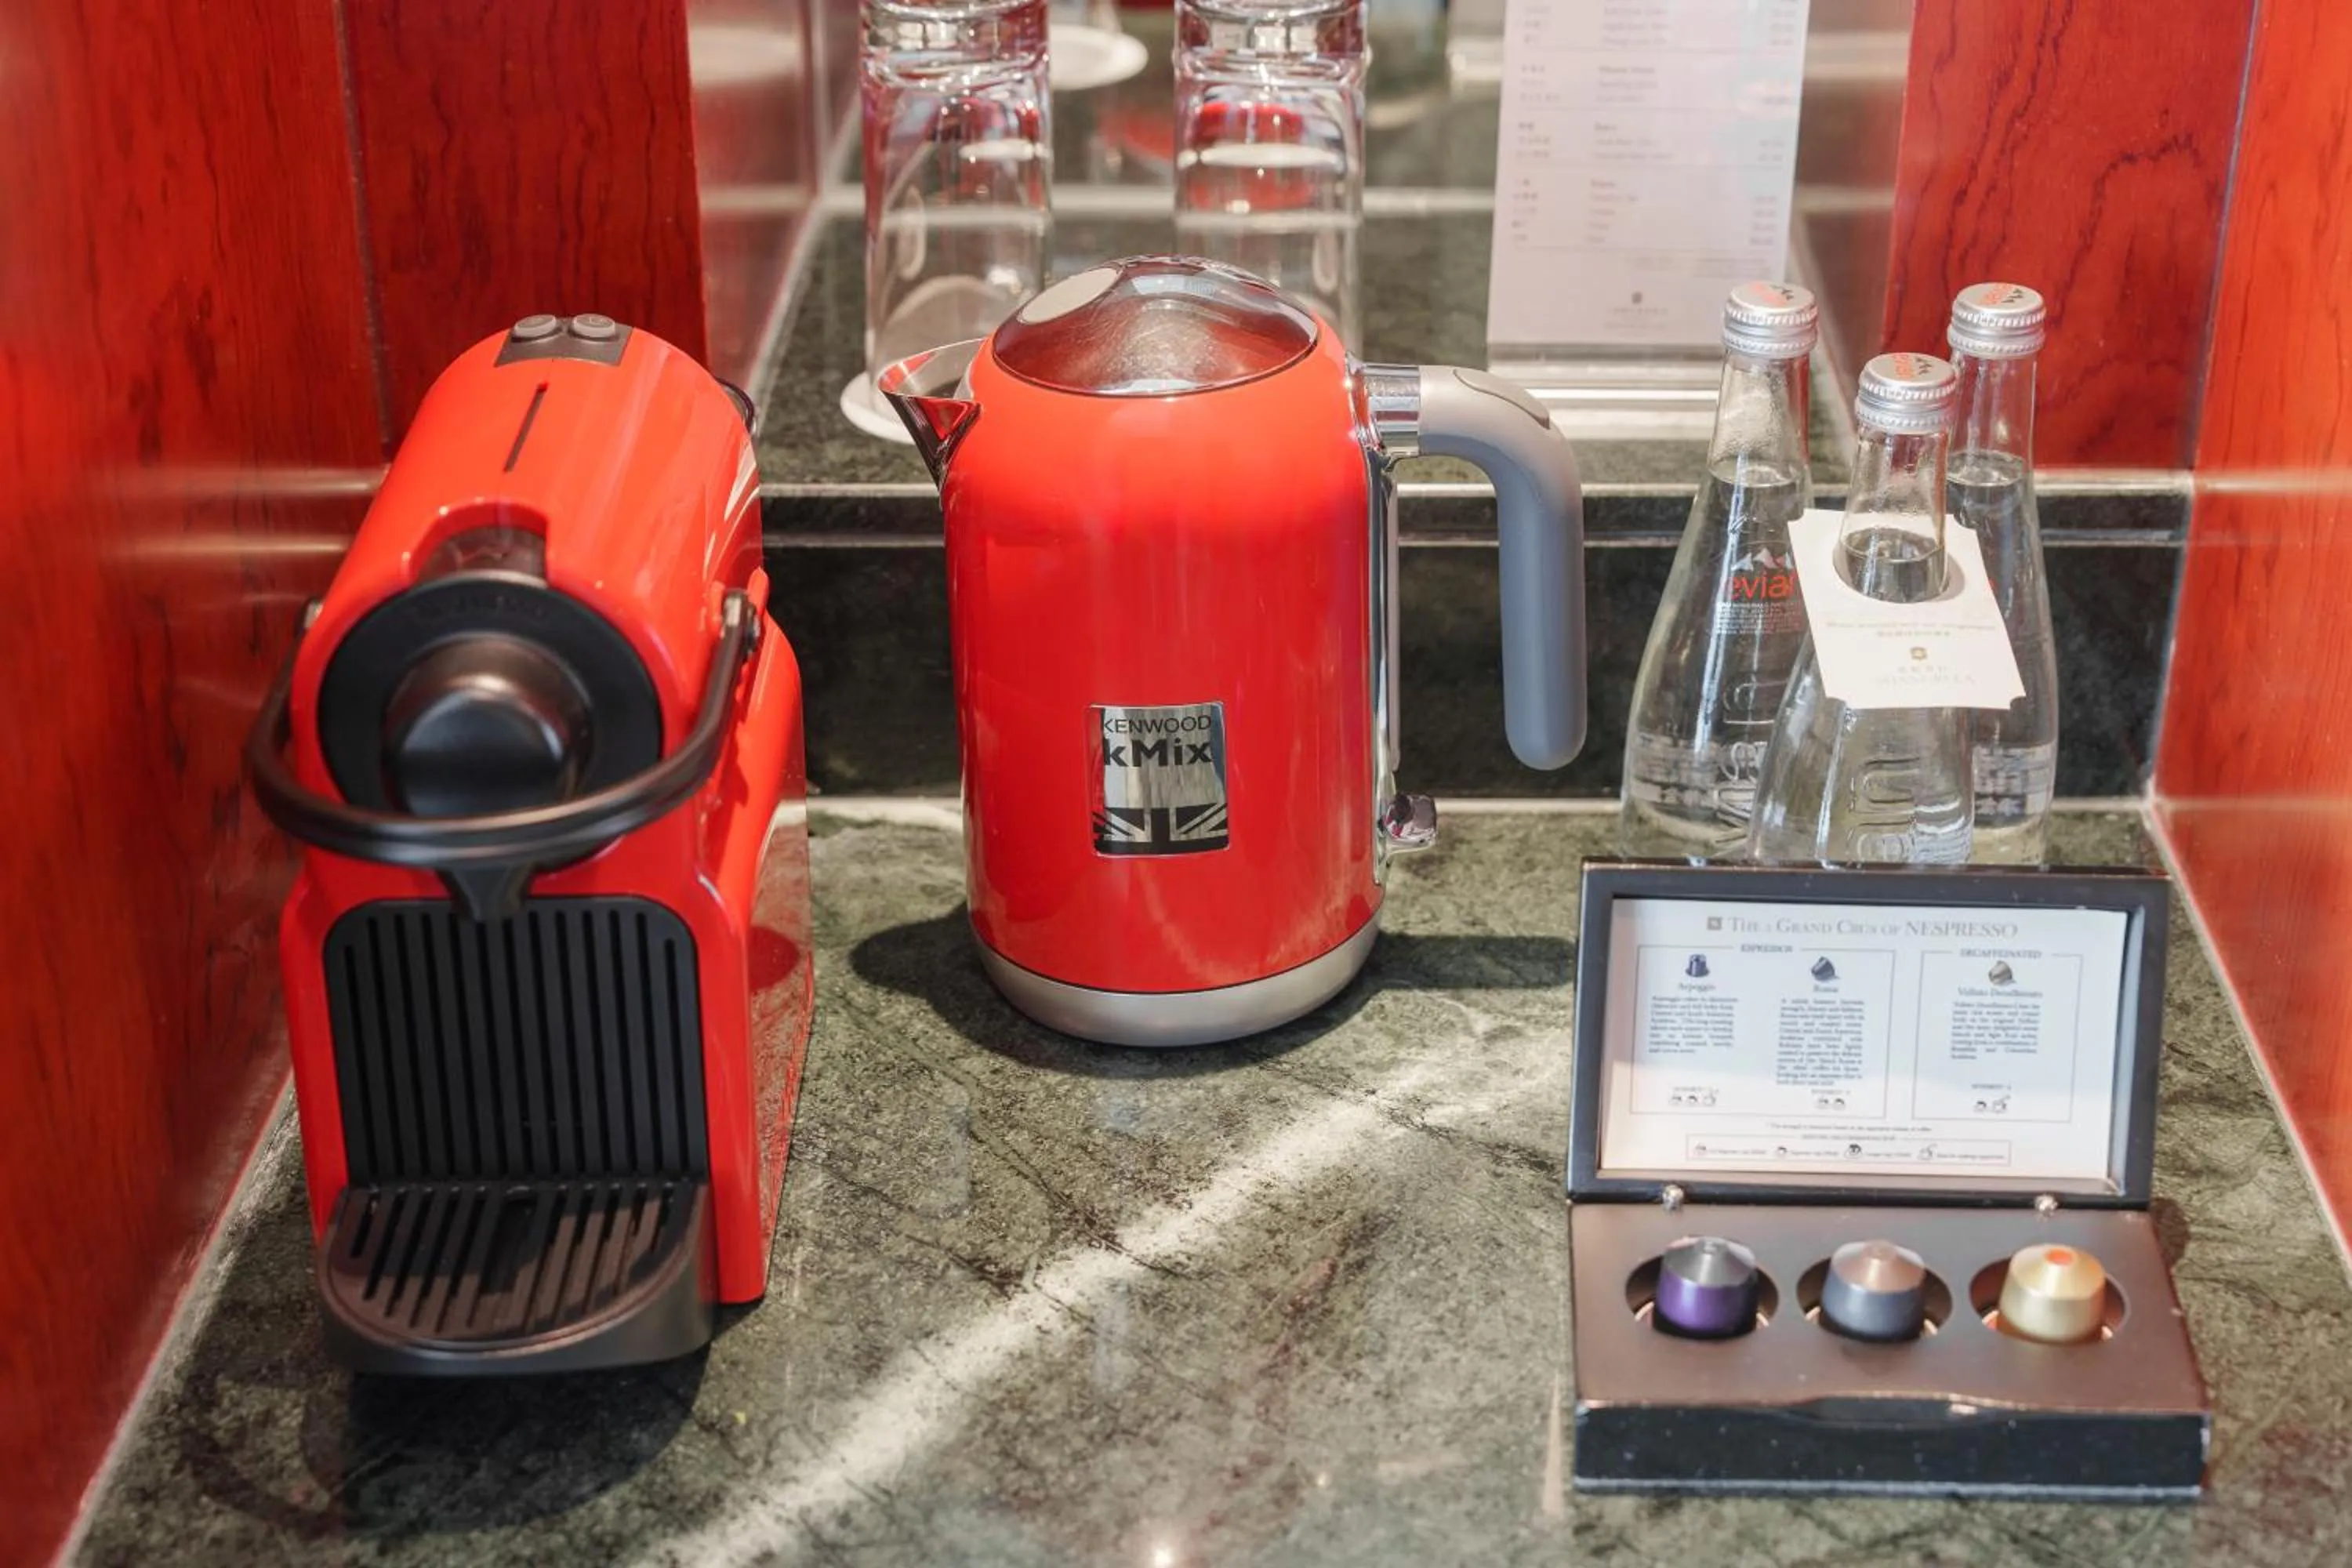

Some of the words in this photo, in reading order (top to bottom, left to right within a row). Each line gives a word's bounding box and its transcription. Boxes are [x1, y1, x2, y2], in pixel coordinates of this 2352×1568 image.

[1102, 715, 1211, 734] KENWOOD
[1102, 738, 1213, 768] kMix
[1776, 917, 1832, 934] GRAND
[1905, 920, 2019, 938] NESPRESSO
